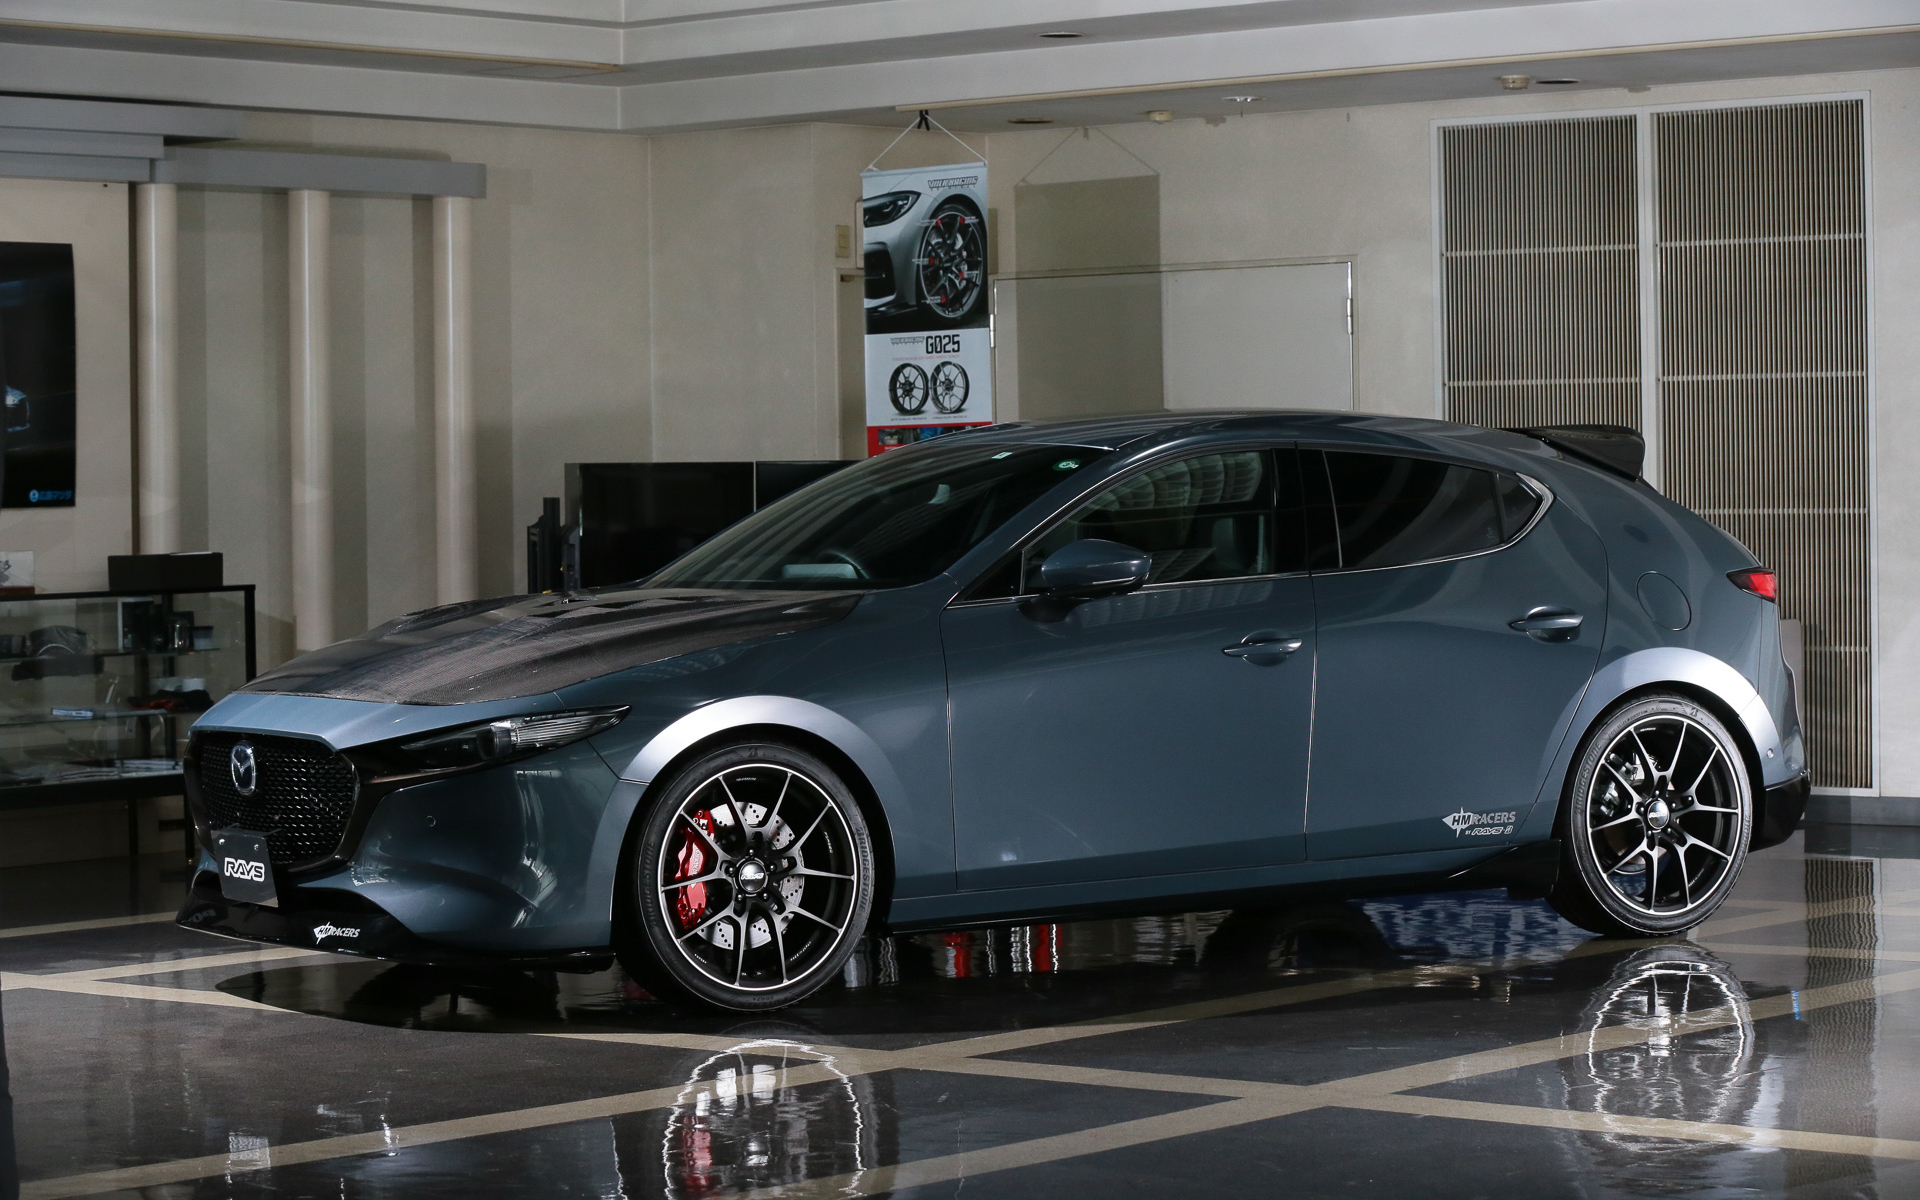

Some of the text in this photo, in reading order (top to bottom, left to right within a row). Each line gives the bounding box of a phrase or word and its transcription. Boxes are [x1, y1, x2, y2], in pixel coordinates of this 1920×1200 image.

[926, 334, 960, 354] G025
[224, 857, 266, 883] RAYS
[855, 827, 872, 914] BRIDGESTONE
